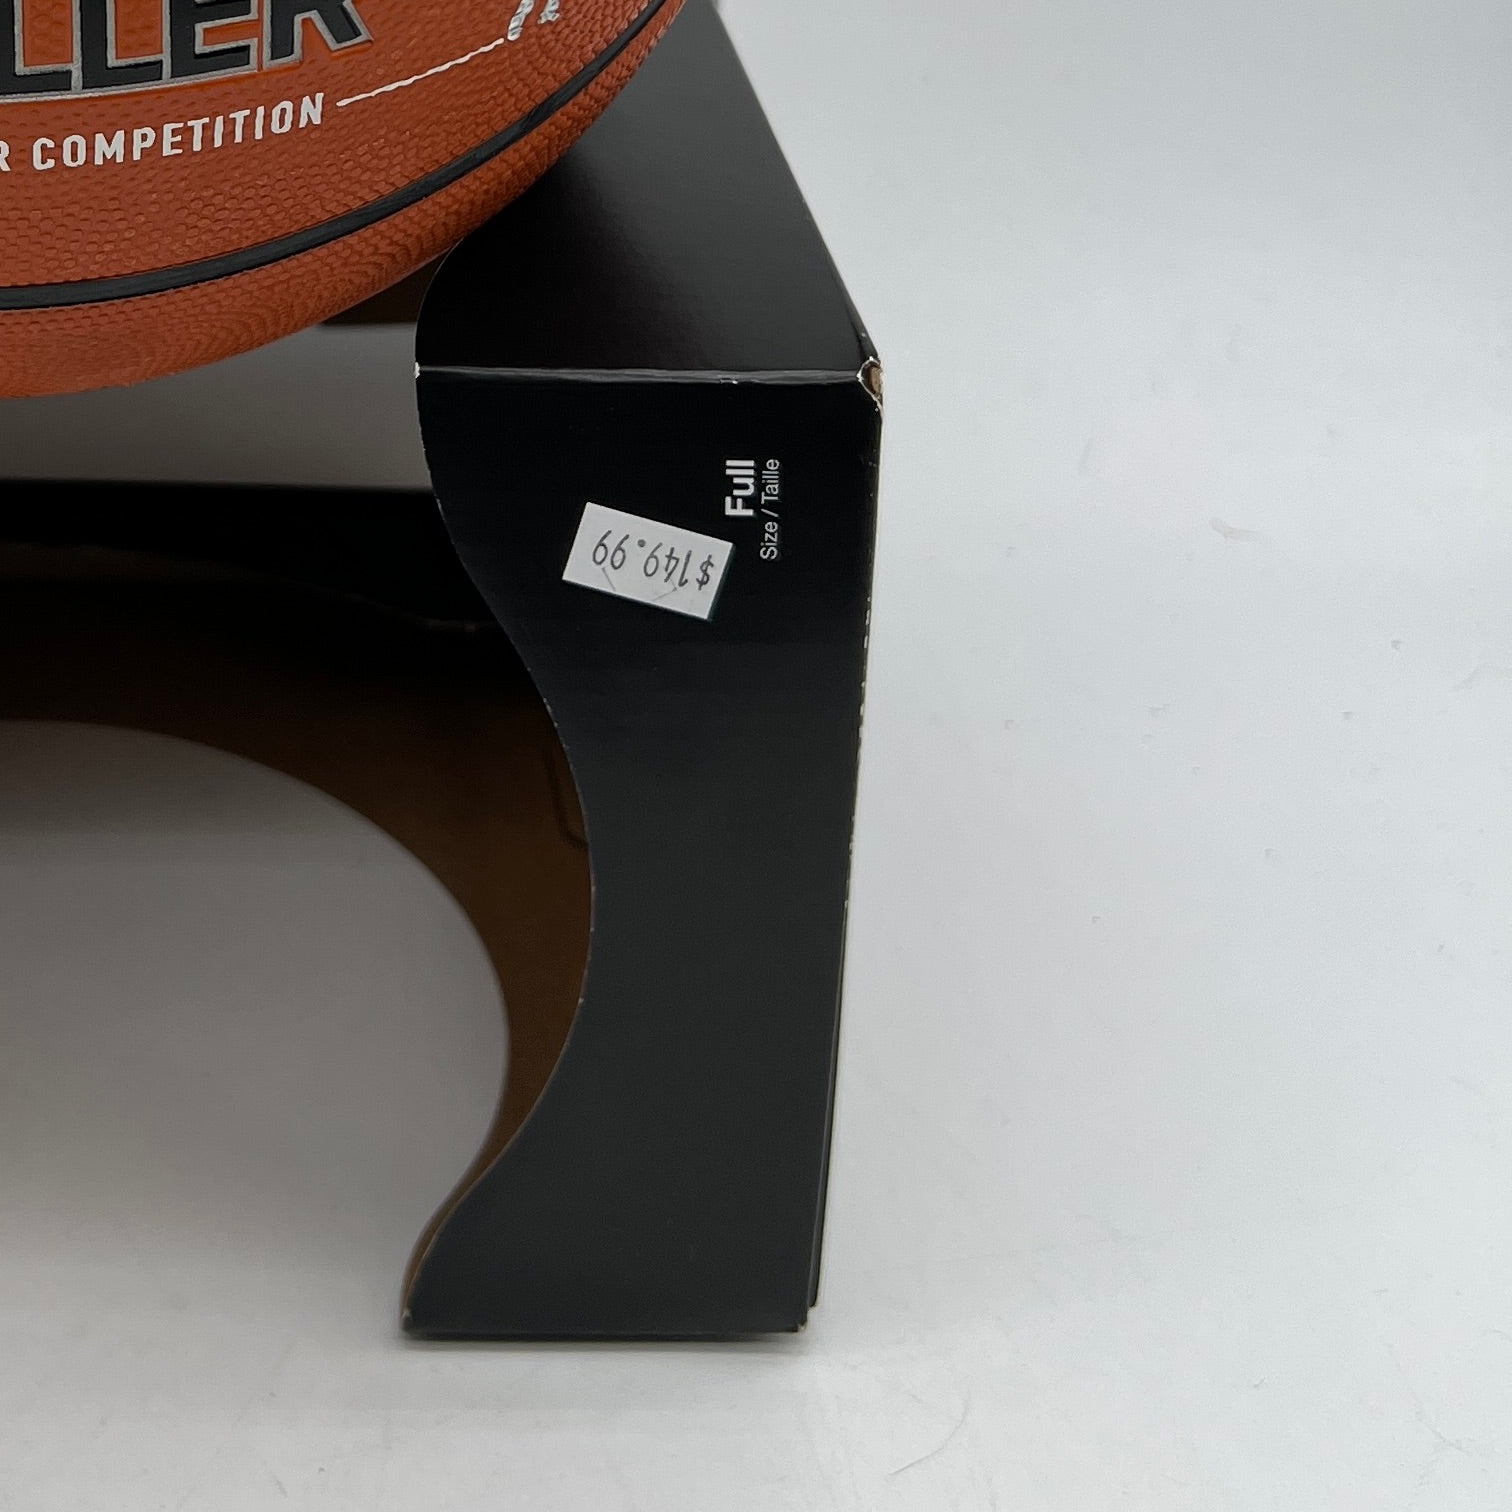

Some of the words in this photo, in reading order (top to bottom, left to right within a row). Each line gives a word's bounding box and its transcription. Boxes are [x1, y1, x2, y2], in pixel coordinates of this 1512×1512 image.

[31, 91, 326, 171] COMPETITION
[724, 459, 755, 517] Full
[760, 458, 780, 505] Taille
[591, 529, 715, 591] $149.99
[759, 521, 779, 560] Size
